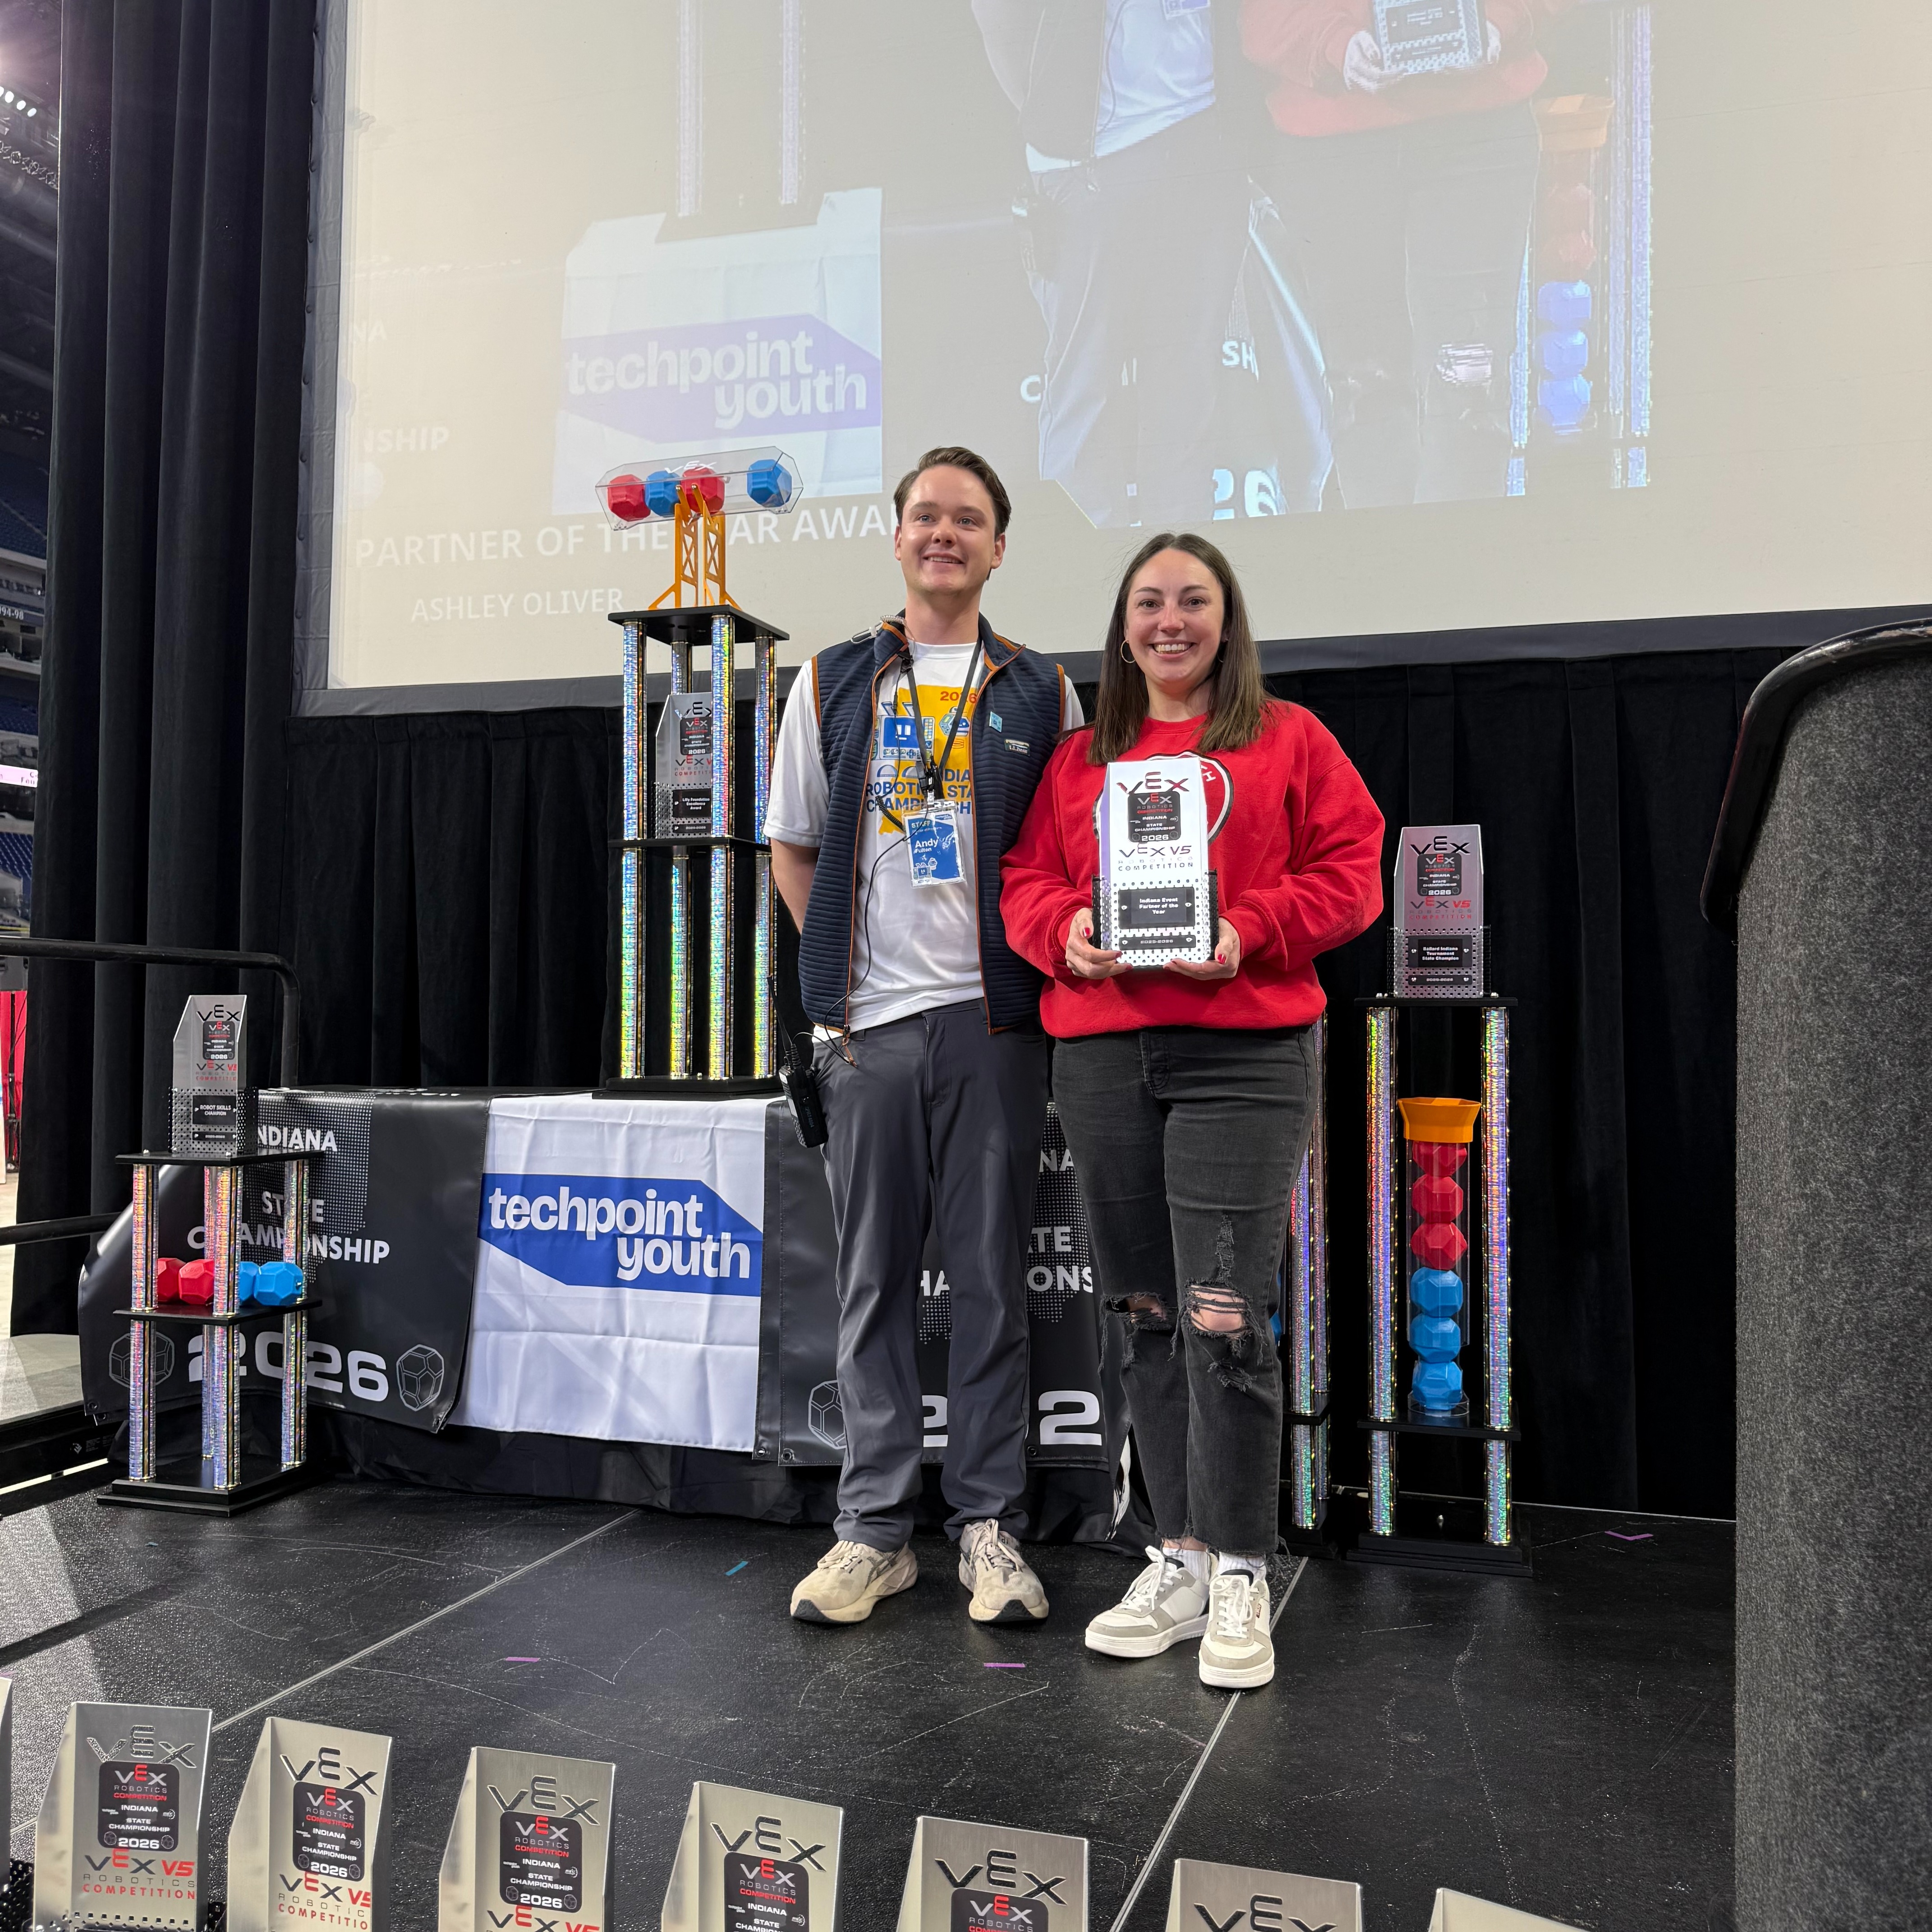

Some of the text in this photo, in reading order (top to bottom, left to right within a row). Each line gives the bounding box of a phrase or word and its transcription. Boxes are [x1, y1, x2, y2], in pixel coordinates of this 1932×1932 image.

[568, 331, 813, 395] techpoint
[715, 363, 867, 430] youth
[664, 460, 717, 473] VEX
[355, 529, 524, 567] PARTNER
[537, 525, 584, 557] OF
[598, 520, 669, 552] THE
[792, 504, 896, 541] AWA
[411, 588, 624, 622] ASHLEY OLIVER
[0, 606, 23, 620] 94-98
[940, 691, 977, 704] 206
[686, 718, 708, 727] VEX
[675, 754, 704, 766] VEX
[1116, 772, 1190, 794] VEX
[1137, 793, 1172, 805] VEX
[915, 838, 938, 848] Andy
[1119, 842, 1191, 858] VEX V5
[1410, 836, 1471, 856] VEX
[1118, 862, 1193, 871] COMPETITION
[1426, 854, 1454, 864] VEX
[1410, 897, 1472, 909] VEX V5
[197, 1004, 240, 1021] VEX
[209, 1021, 230, 1031] VEX
[196, 1059, 225, 1071] VEX
[258, 1126, 337, 1152] NDIANA
[263, 1191, 324, 1223] STE
[489, 1187, 703, 1240] techpoint
[616, 1233, 750, 1281] youth
[86, 1725, 197, 1768] VEX
[114, 1764, 167, 1786] VEX
[280, 1747, 379, 1796] VEX
[114, 1785, 167, 1793] ROBOTICS
[114, 1793, 167, 1801] COMPETITION
[307, 1788, 354, 1813] VEX
[488, 1775, 600, 1826] VEX
[306, 1807, 354, 1821] ROBOTICS
[109, 1824, 170, 1832] CHAMPIONSHIP
[313, 1828, 346, 1840] INDIANA
[515, 1816, 569, 1841] VEX
[118, 1838, 160, 1849] 2026
[317, 1842, 340, 1851] STATE
[515, 1837, 569, 1849] ROBOTICS
[710, 1815, 827, 1872] VEX
[302, 1846, 357, 1861] CHAMPIONSHIP
[515, 1845, 569, 1857] COMPETITION
[85, 1848, 195, 1877] VEX V5
[311, 1862, 348, 1877] 2026
[523, 1858, 560, 1869] INDIANA
[83, 1874, 195, 1887] ROBOTICS
[528, 1873, 553, 1881] STATE
[740, 1859, 796, 1887] VEX
[934, 1849, 1068, 1906] VEX
[83, 1884, 195, 1900] COMPETITION
[280, 1872, 343, 1902] VEX
[510, 1878, 573, 1891] CHAMPIONSHIP
[740, 1880, 796, 1895] ROBOTICS
[520, 1893, 562, 1908] 2026
[740, 1888, 796, 1904] COMPETITION
[748, 1903, 787, 1916] INDIANA
[970, 1895, 1033, 1924] VEX
[487, 1905, 560, 1932] VEX
[754, 1918, 780, 1928] STATE
[969, 1917, 1033, 1932] ROBOTICS
